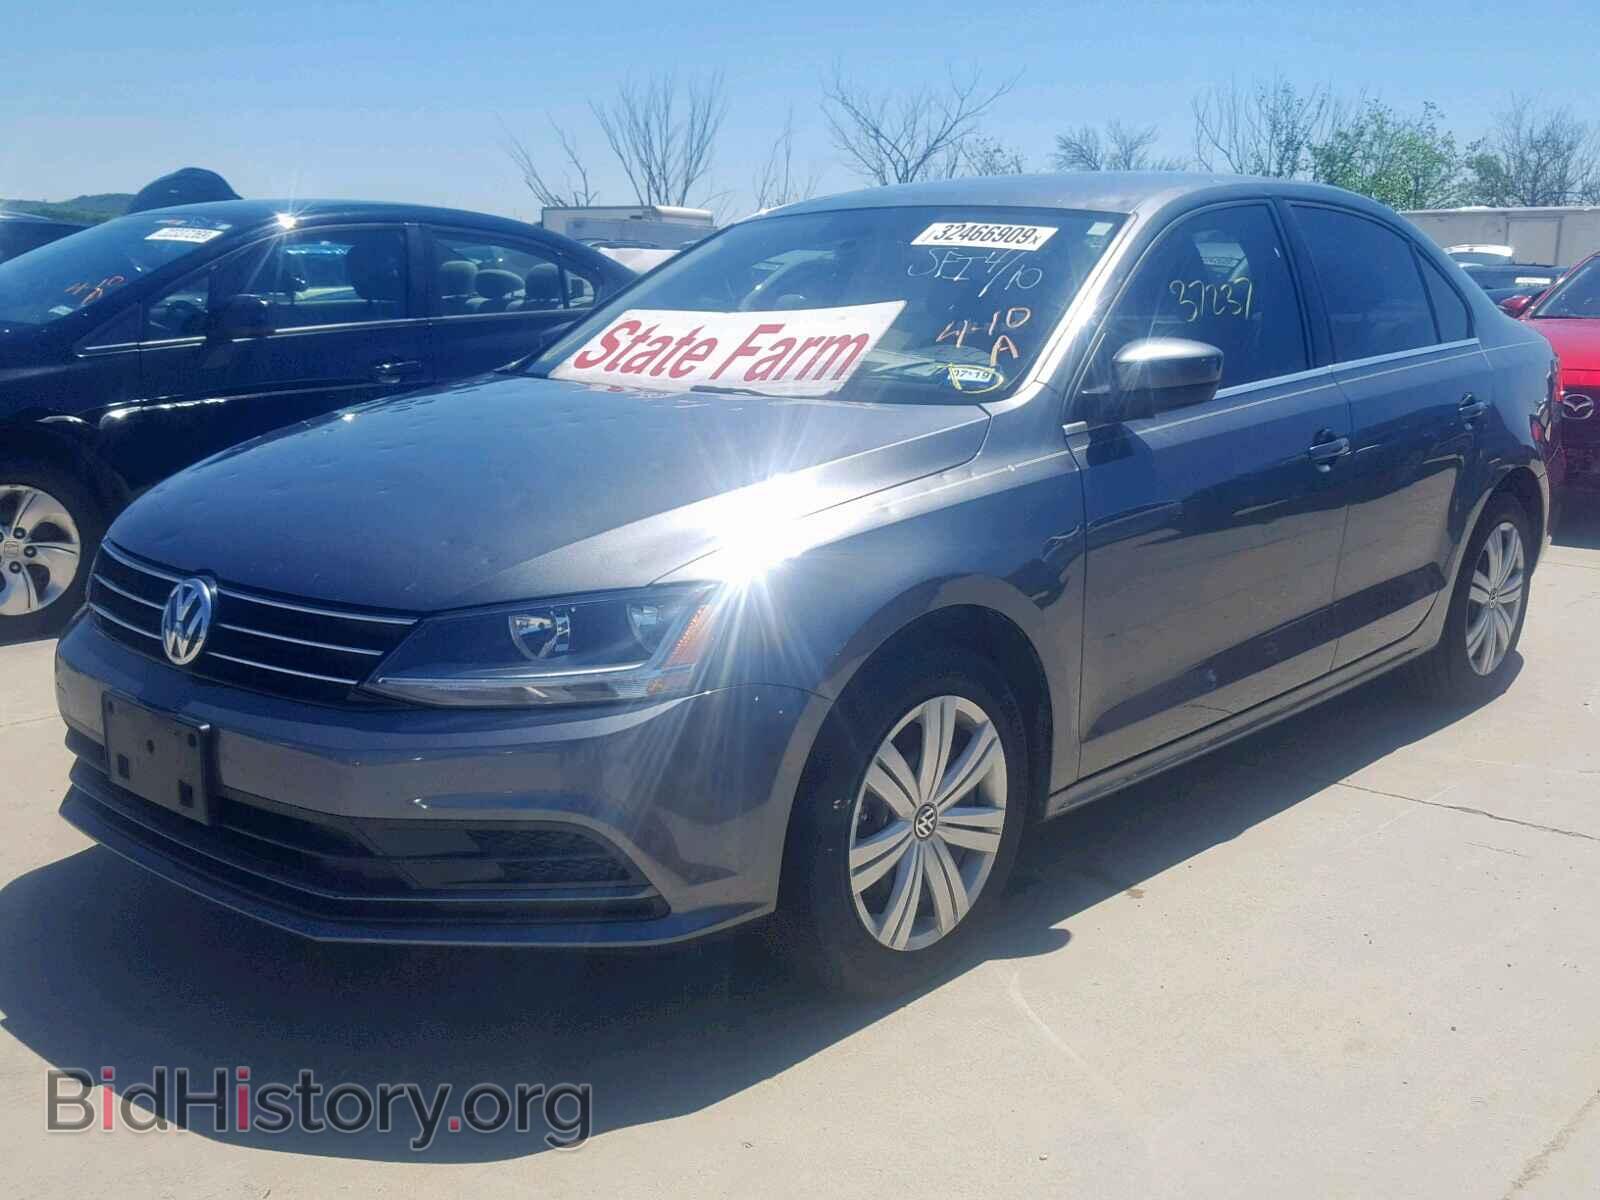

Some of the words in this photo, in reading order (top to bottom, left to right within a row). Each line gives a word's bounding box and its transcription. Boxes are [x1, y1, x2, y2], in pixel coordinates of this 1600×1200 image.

[935, 306, 1031, 348] 4-10
[573, 319, 719, 379] State
[709, 323, 870, 383] Farm
[989, 335, 1019, 367] A
